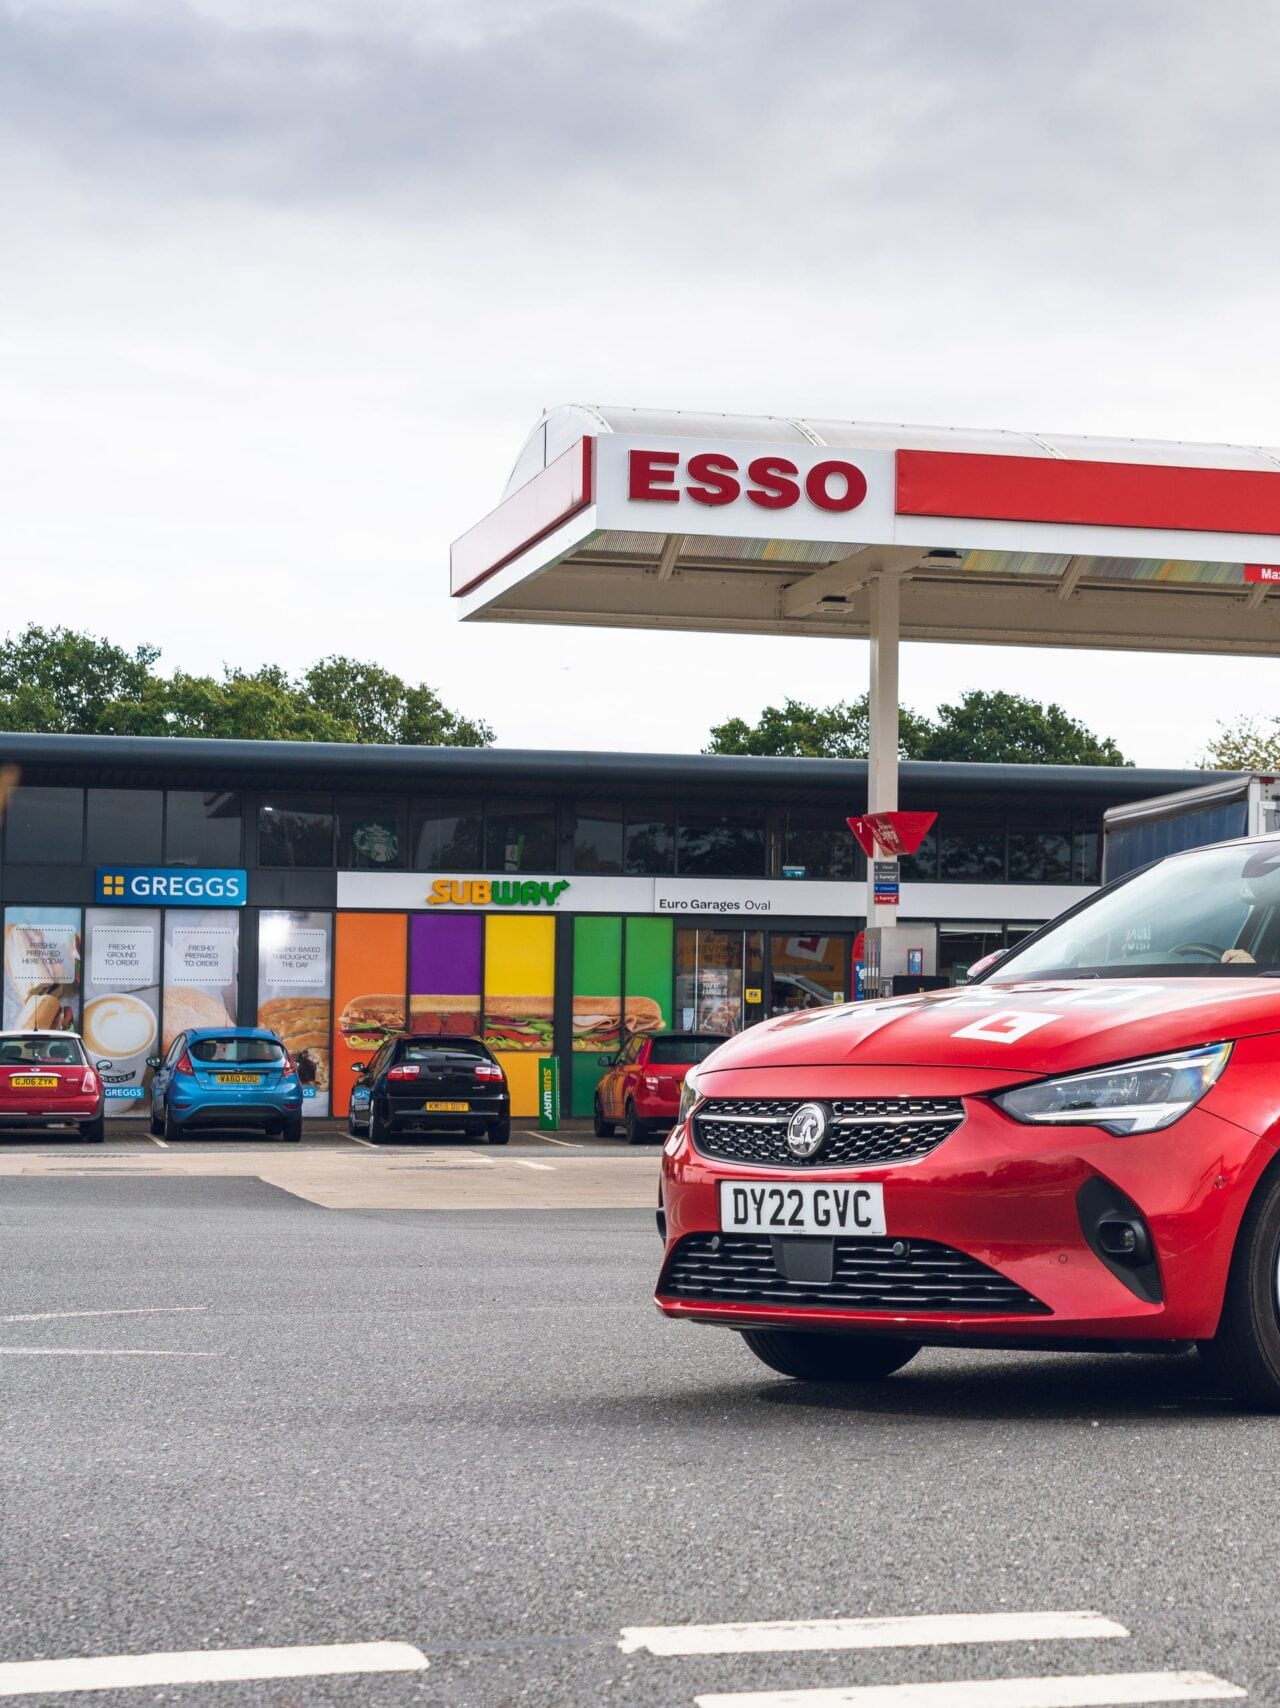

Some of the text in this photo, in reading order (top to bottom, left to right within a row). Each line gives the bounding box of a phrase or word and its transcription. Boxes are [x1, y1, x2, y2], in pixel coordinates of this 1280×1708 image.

[627, 449, 868, 513] ESSO
[856, 822, 863, 833] 1
[131, 875, 239, 897] GREGGS
[426, 879, 570, 906] SUBWAY
[659, 899, 771, 912] Euro Garages Oval
[105, 1088, 142, 1097] GREGGS
[543, 1067, 552, 1120] SUBWAY
[733, 1188, 872, 1228] DY22 GVC
